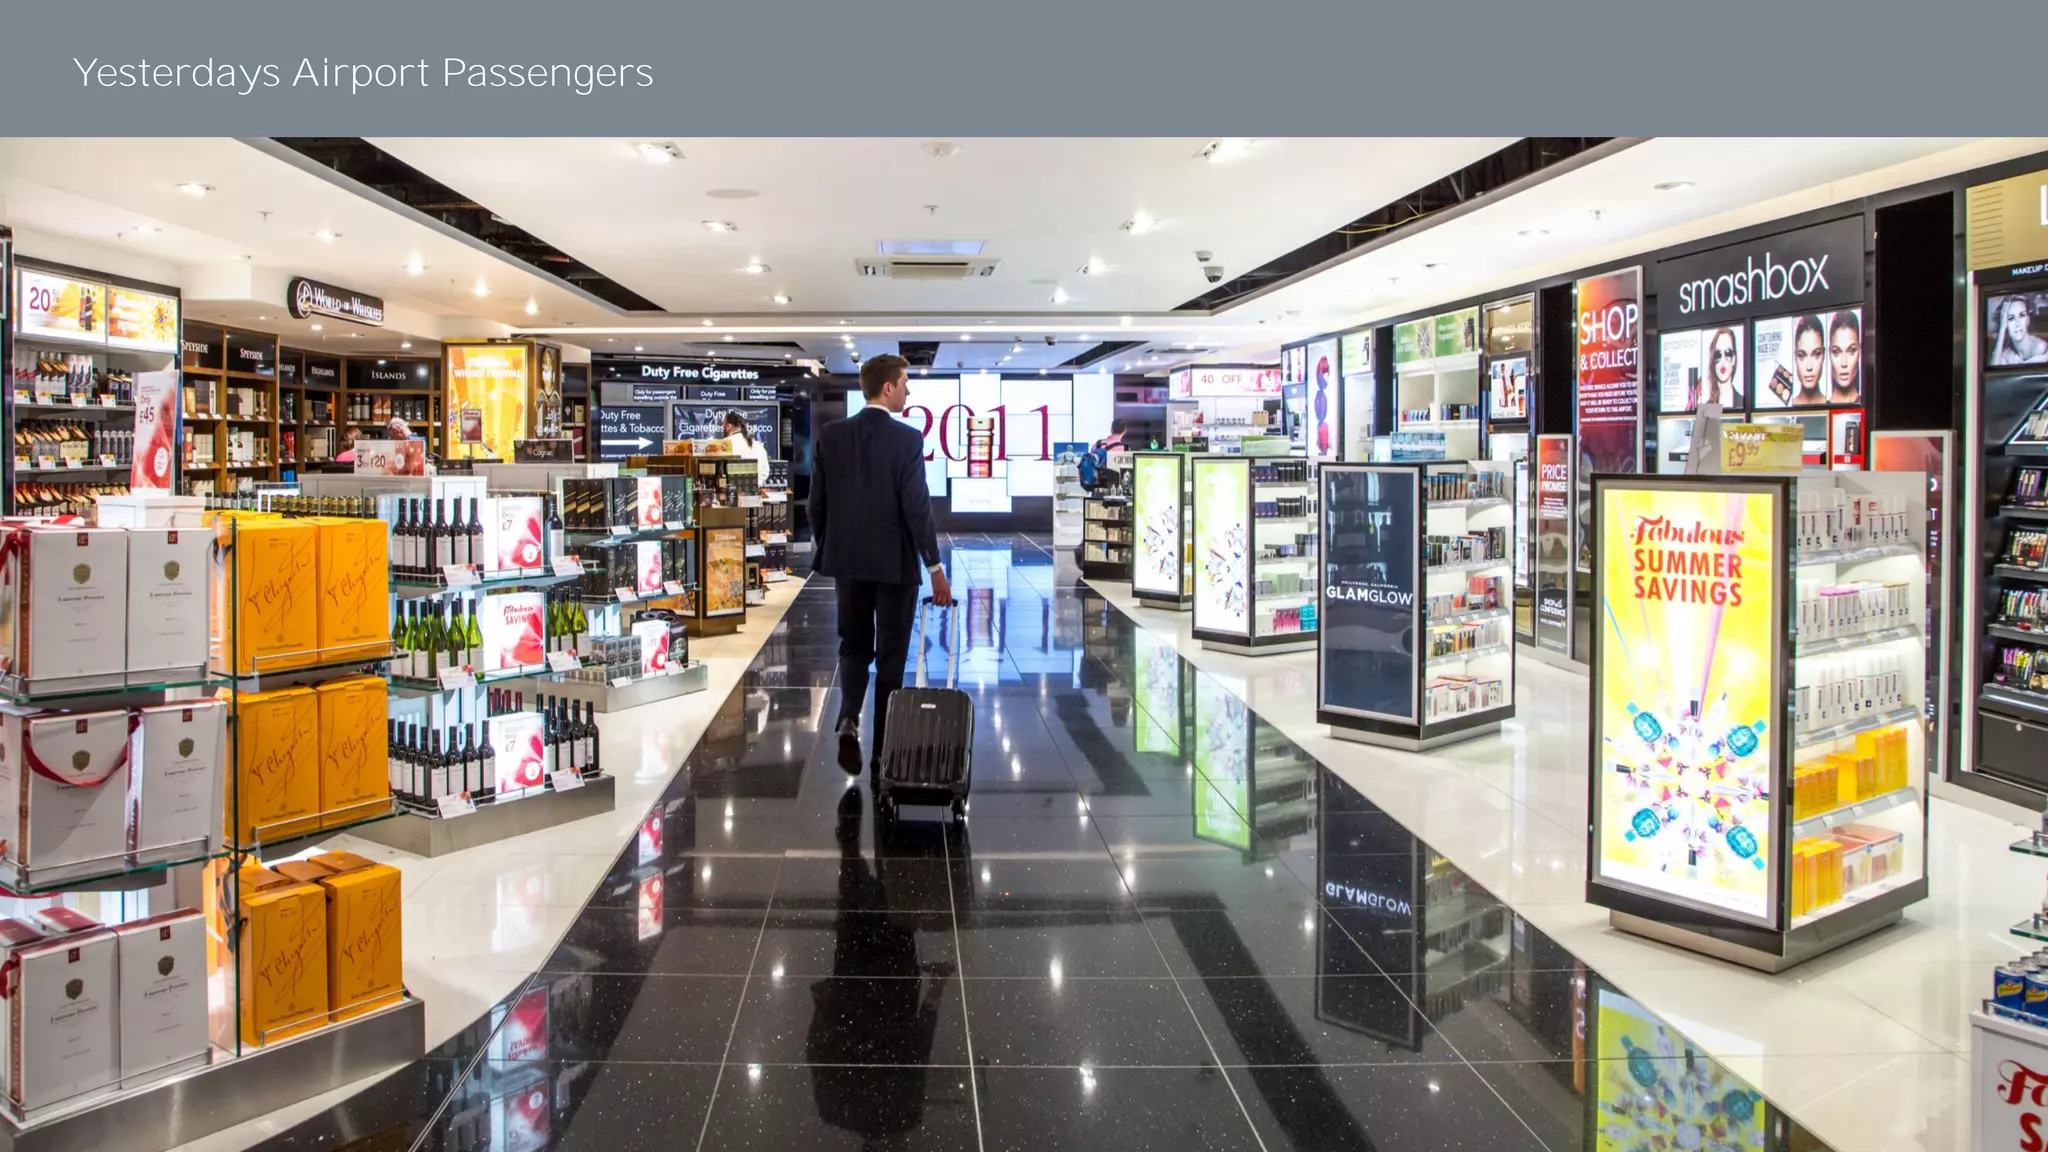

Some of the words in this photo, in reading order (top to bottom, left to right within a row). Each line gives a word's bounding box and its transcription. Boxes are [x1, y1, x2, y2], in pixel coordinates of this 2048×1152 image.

[2011, 264, 2043, 276] MAKEUP
[1679, 252, 1830, 314] smashbox
[314, 287, 341, 312] WORLD
[351, 297, 383, 321] WHISKIES
[1580, 303, 1638, 345] SHOP
[181, 339, 209, 354] SPEYSIDE
[240, 348, 264, 361] SPEYSIDE
[1580, 354, 1588, 371] &
[1590, 347, 1638, 369] COLLECT
[311, 365, 335, 377] HIGHLANDS
[371, 371, 407, 381] ISLANDS
[642, 365, 671, 380] Duty
[673, 367, 699, 378] Free
[701, 367, 760, 381] Cigarettes
[1201, 374, 1214, 385] 40
[1222, 374, 1243, 384] OFF
[700, 391, 713, 399] Duty
[139, 406, 154, 423] £45
[621, 410, 641, 421] Free
[704, 409, 727, 422] Duty
[620, 423, 628, 434] &
[629, 423, 665, 434] Tobacco
[679, 422, 724, 435] Cigarettes
[902, 404, 1053, 462] 2011
[356, 455, 363, 467] 3
[370, 454, 386, 468] £20
[533, 449, 554, 459] Cognac
[1541, 464, 1567, 481] PRICE
[1541, 481, 1567, 492] PROMISE
[502, 519, 513, 532] £7
[1630, 514, 1745, 546] Fabulous
[1633, 548, 1743, 579] SUMMER
[1326, 585, 1413, 606] GLAMGLOW
[1633, 575, 1743, 607] SAVINGS
